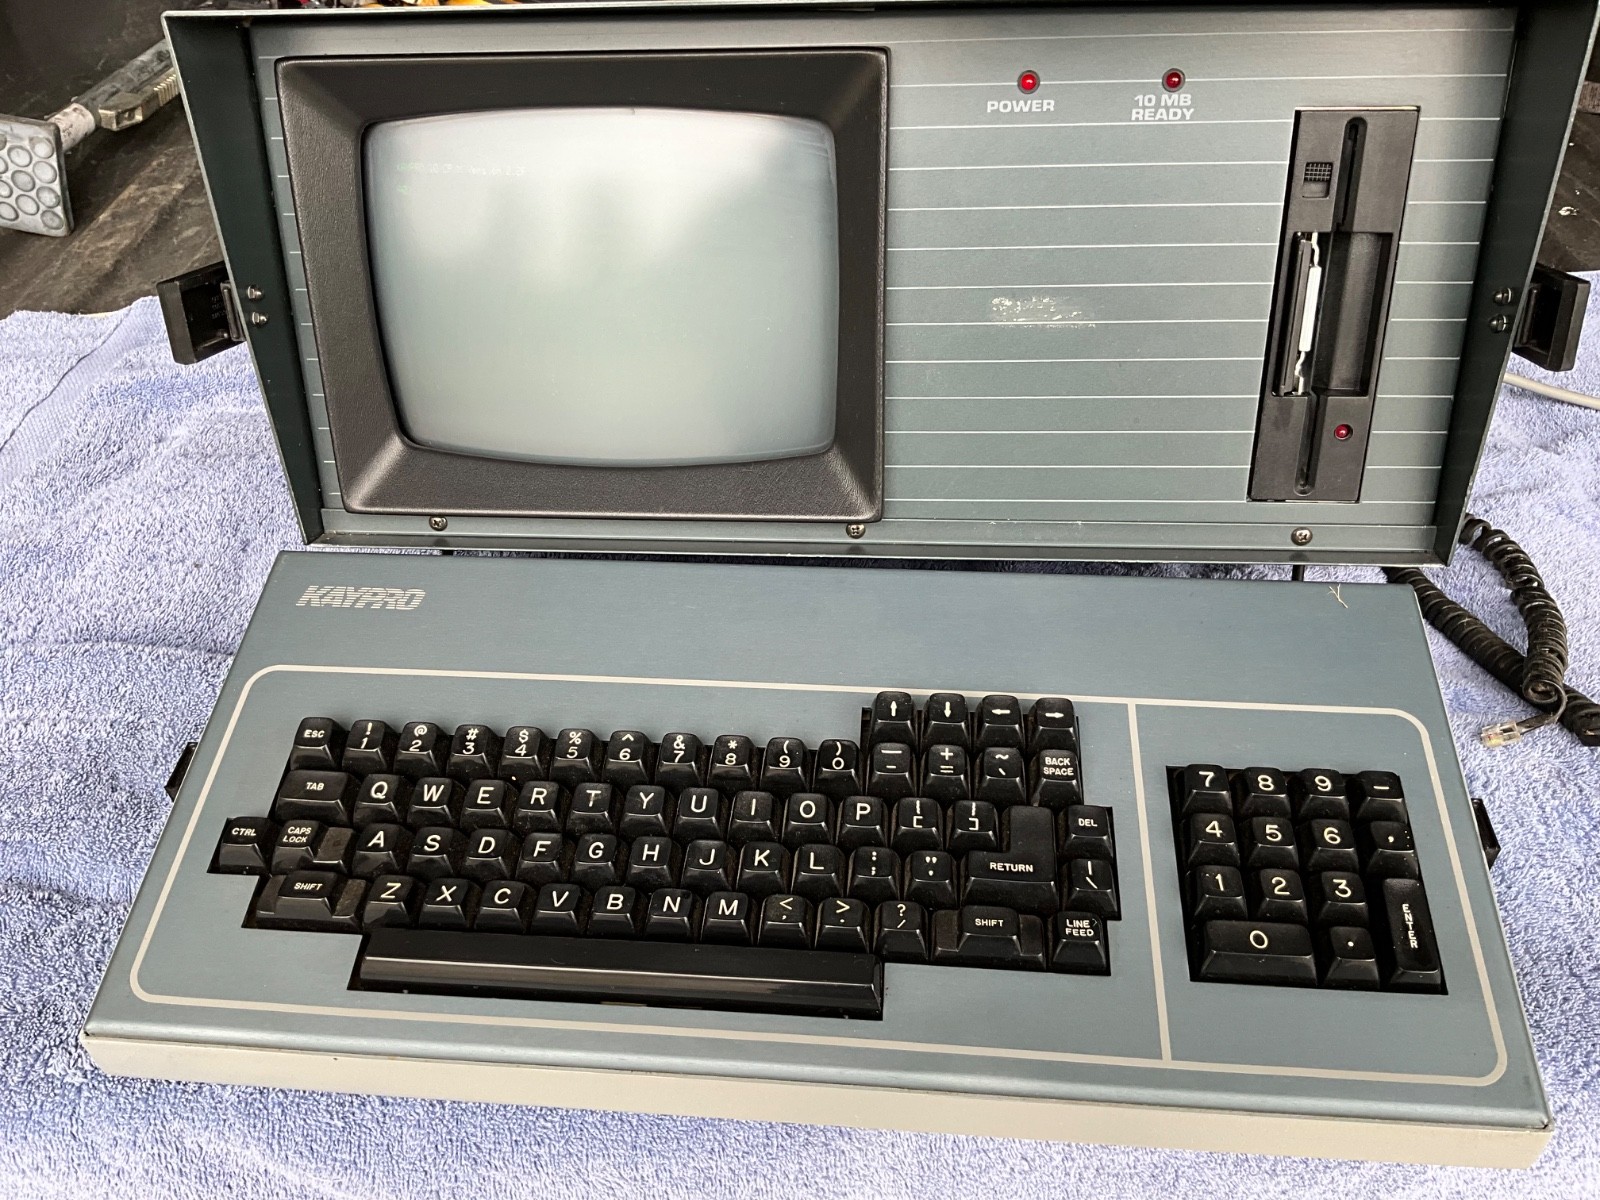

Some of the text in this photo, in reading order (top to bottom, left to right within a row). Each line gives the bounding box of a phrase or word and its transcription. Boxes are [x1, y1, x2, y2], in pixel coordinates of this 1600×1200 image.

[986, 99, 1055, 113] POWER
[1134, 93, 1192, 107] 10 MB
[1130, 107, 1195, 121] READY
[295, 585, 426, 610] KAYPRO
[303, 729, 325, 738] ESC
[365, 721, 373, 736] !
[413, 724, 428, 737] @
[465, 727, 480, 741] #
[518, 728, 530, 744] $
[360, 736, 369, 749] 1
[408, 739, 422, 752] 2
[568, 730, 582, 745] %
[673, 734, 686, 750] &
[462, 741, 475, 755] 3
[514, 743, 527, 757] 4
[565, 746, 578, 760] 5
[619, 747, 631, 761] 6
[673, 749, 685, 764] 7
[723, 752, 737, 766] 8
[779, 755, 791, 768] 9
[1044, 756, 1071, 767] BACK
[1043, 766, 1074, 776] SPACE
[1198, 770, 1215, 788] 7
[306, 781, 325, 791] TAB
[370, 780, 388, 800] Q
[1257, 774, 1275, 791] 8
[1314, 775, 1332, 792] 9
[423, 783, 445, 802] W
[476, 786, 495, 805] E
[530, 787, 548, 805] R
[585, 789, 602, 807] T
[639, 791, 655, 810] Y
[690, 794, 708, 813] U
[855, 802, 871, 821] P
[287, 826, 312, 835] CAPS
[1078, 817, 1098, 827] DEL
[1205, 820, 1223, 838] 4
[231, 827, 257, 837] CTRL
[282, 835, 308, 844] LOCK
[367, 830, 385, 848] A
[1265, 824, 1282, 842] 5
[1323, 826, 1341, 845] 6
[423, 834, 441, 852] S
[477, 836, 496, 854] D
[533, 840, 552, 857] F
[588, 841, 605, 859] G
[642, 843, 660, 862] H
[698, 848, 716, 866] J
[754, 848, 771, 867] K
[809, 851, 825, 870] L
[989, 861, 1034, 873] RETURN
[293, 882, 323, 891] SHIFT
[380, 882, 402, 899] Z
[1215, 873, 1225, 892] 1
[1271, 876, 1291, 896] 2
[1332, 878, 1352, 898] 3
[435, 885, 457, 902] X
[494, 887, 512, 905] C
[552, 890, 570, 908] V
[606, 893, 624, 910] B
[662, 895, 681, 913] N
[718, 898, 739, 916] M
[897, 903, 906, 917] ?
[974, 918, 1004, 927] SHIFT
[1066, 918, 1091, 928] LINE
[1401, 903, 1419, 949] ENTER
[1065, 927, 1094, 937] FEED
